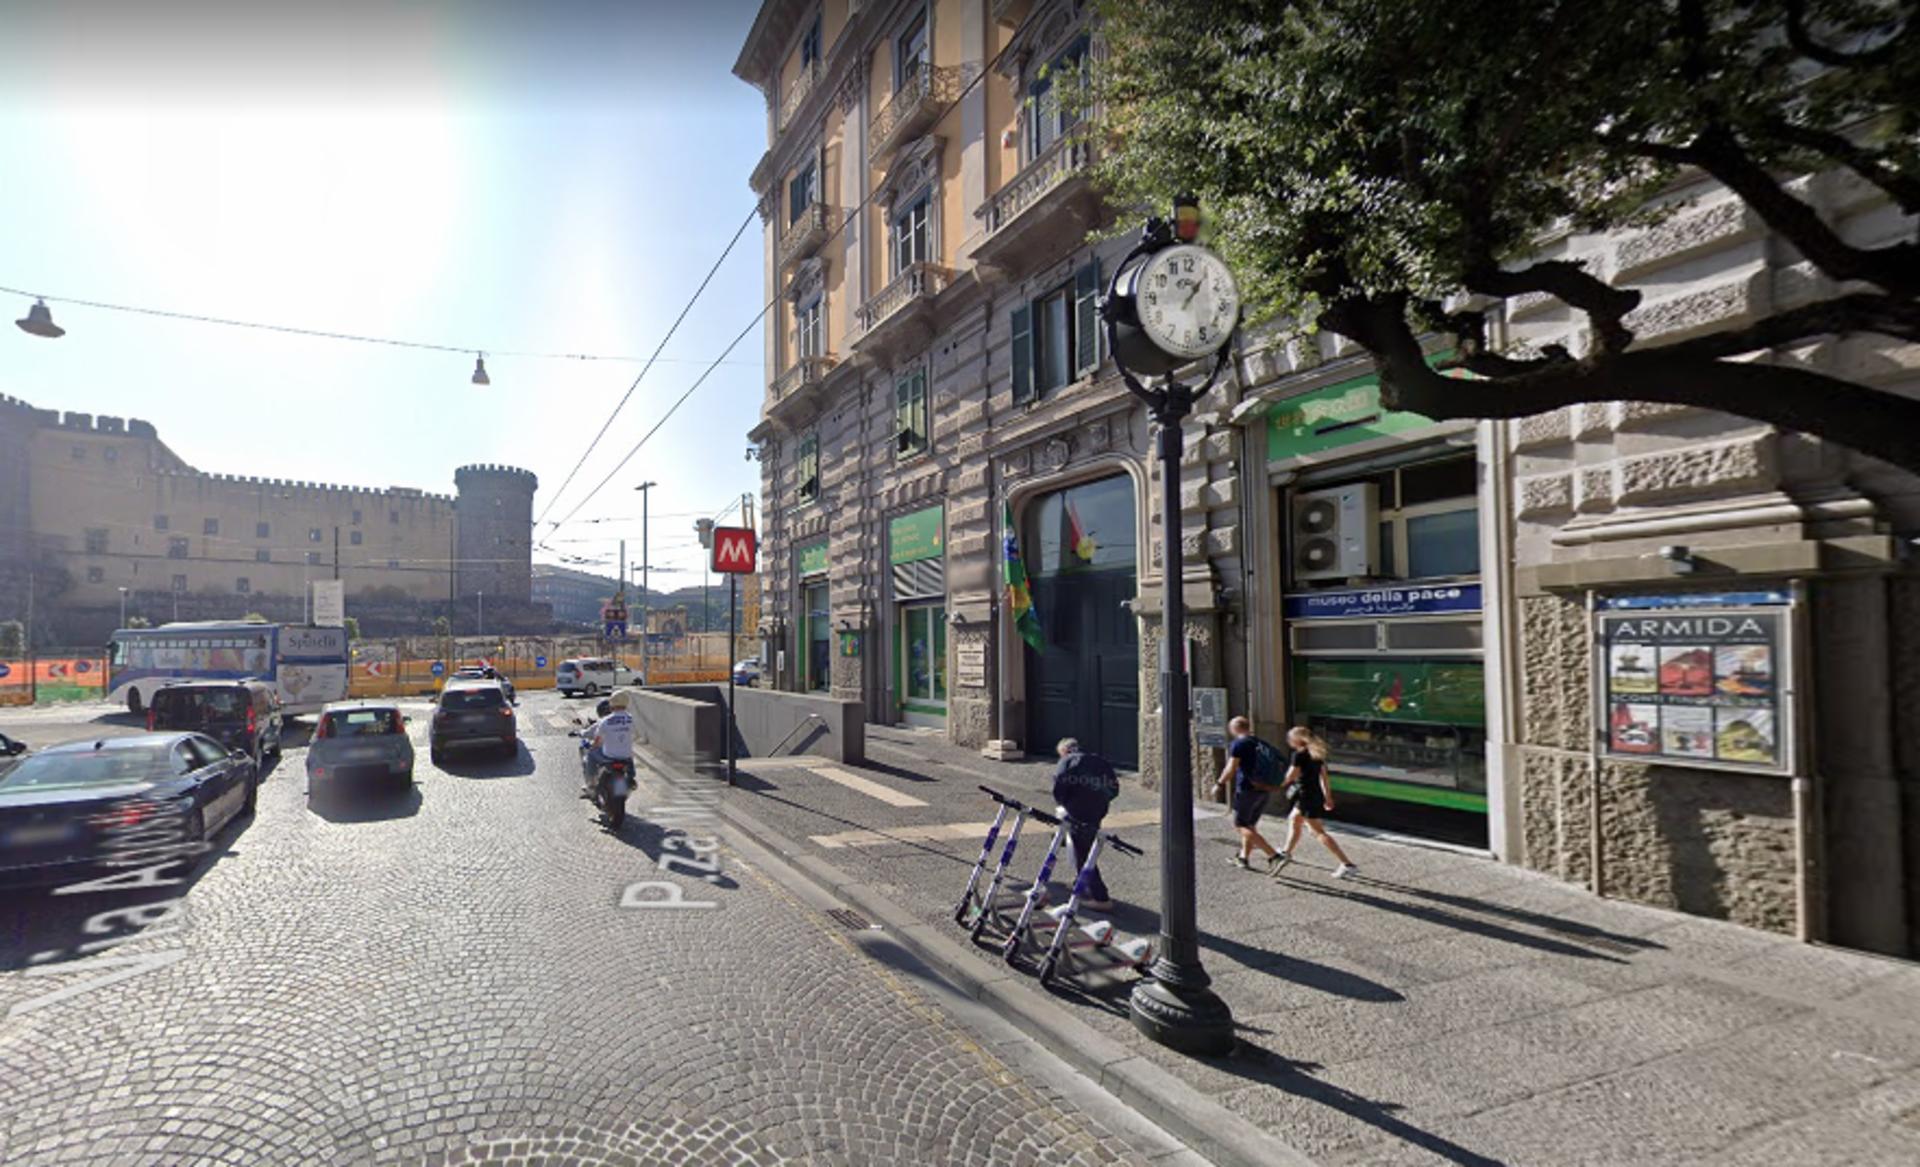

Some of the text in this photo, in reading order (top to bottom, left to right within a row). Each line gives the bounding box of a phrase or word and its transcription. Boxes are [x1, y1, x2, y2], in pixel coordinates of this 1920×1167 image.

[1169, 261, 1178, 275] 11
[1183, 258, 1194, 272] 12
[1155, 273, 1167, 288] 10
[1168, 324, 1176, 338] 7
[1184, 330, 1191, 344] 6
[1199, 327, 1207, 340] 5
[718, 537, 750, 563] M
[1308, 588, 1461, 607] museo della pace
[1614, 617, 1763, 637] ARMIDA
